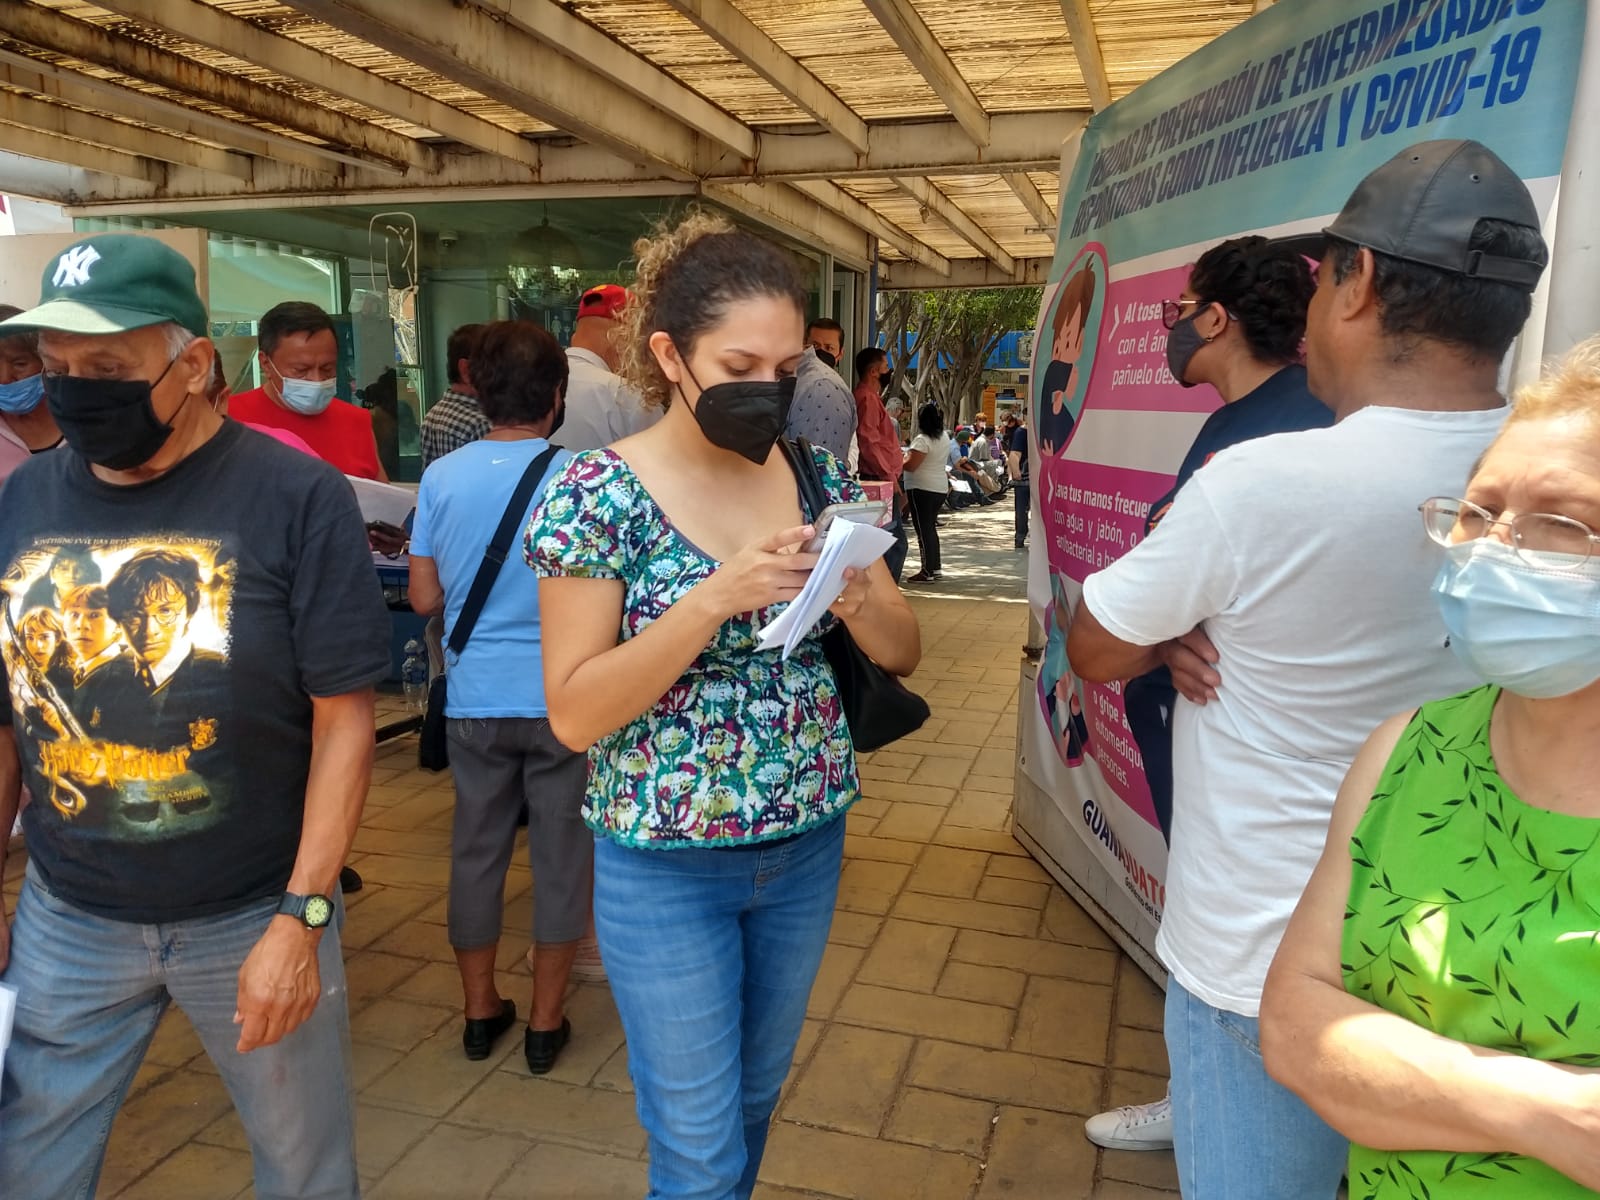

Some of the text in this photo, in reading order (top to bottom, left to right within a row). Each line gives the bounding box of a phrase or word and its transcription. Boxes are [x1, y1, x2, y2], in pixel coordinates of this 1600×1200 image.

[1256, 46, 1296, 111] DE
[1289, 0, 1545, 99] ENFERMEDAD
[1156, 139, 1215, 204] COMO
[1208, 92, 1333, 186] INFLUENZA
[1336, 82, 1361, 148] Y
[1360, 26, 1541, 141] COVID-19
[1123, 302, 1137, 325] Al
[1117, 338, 1136, 355] con
[1137, 330, 1149, 353] el
[1111, 362, 1153, 391] pañuelo
[1069, 484, 1082, 503] tus
[1083, 490, 1113, 511] manos
[1066, 512, 1083, 534] agua
[1088, 519, 1093, 539] y
[1096, 517, 1124, 549] jabón,
[1097, 552, 1102, 568] a
[1099, 694, 1119, 723] gripe
[1097, 743, 1130, 788] personas.
